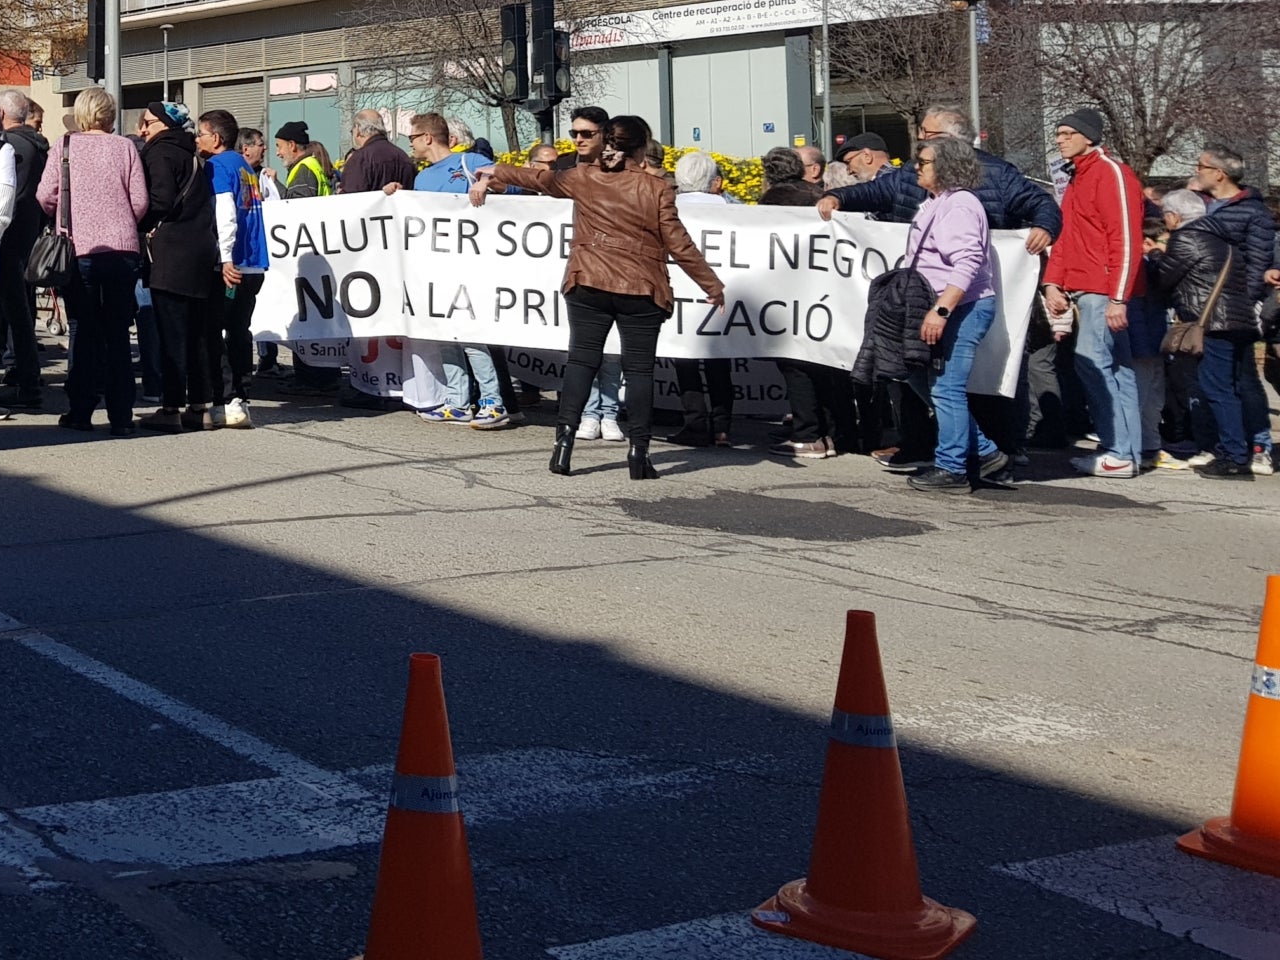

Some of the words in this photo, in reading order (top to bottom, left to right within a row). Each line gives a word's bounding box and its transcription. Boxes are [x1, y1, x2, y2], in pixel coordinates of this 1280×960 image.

[652, 11, 682, 21] Centre
[683, 7, 695, 17] de
[696, 1, 752, 16] recuperació
[753, 0, 767, 9] de
[270, 215, 394, 259] SALUT
[404, 216, 481, 255] PER
[294, 270, 382, 322] NO
[428, 281, 476, 320] LA
[310, 342, 348, 357] Sanit
[362, 372, 379, 386] de
[732, 384, 789, 401] BLIC
